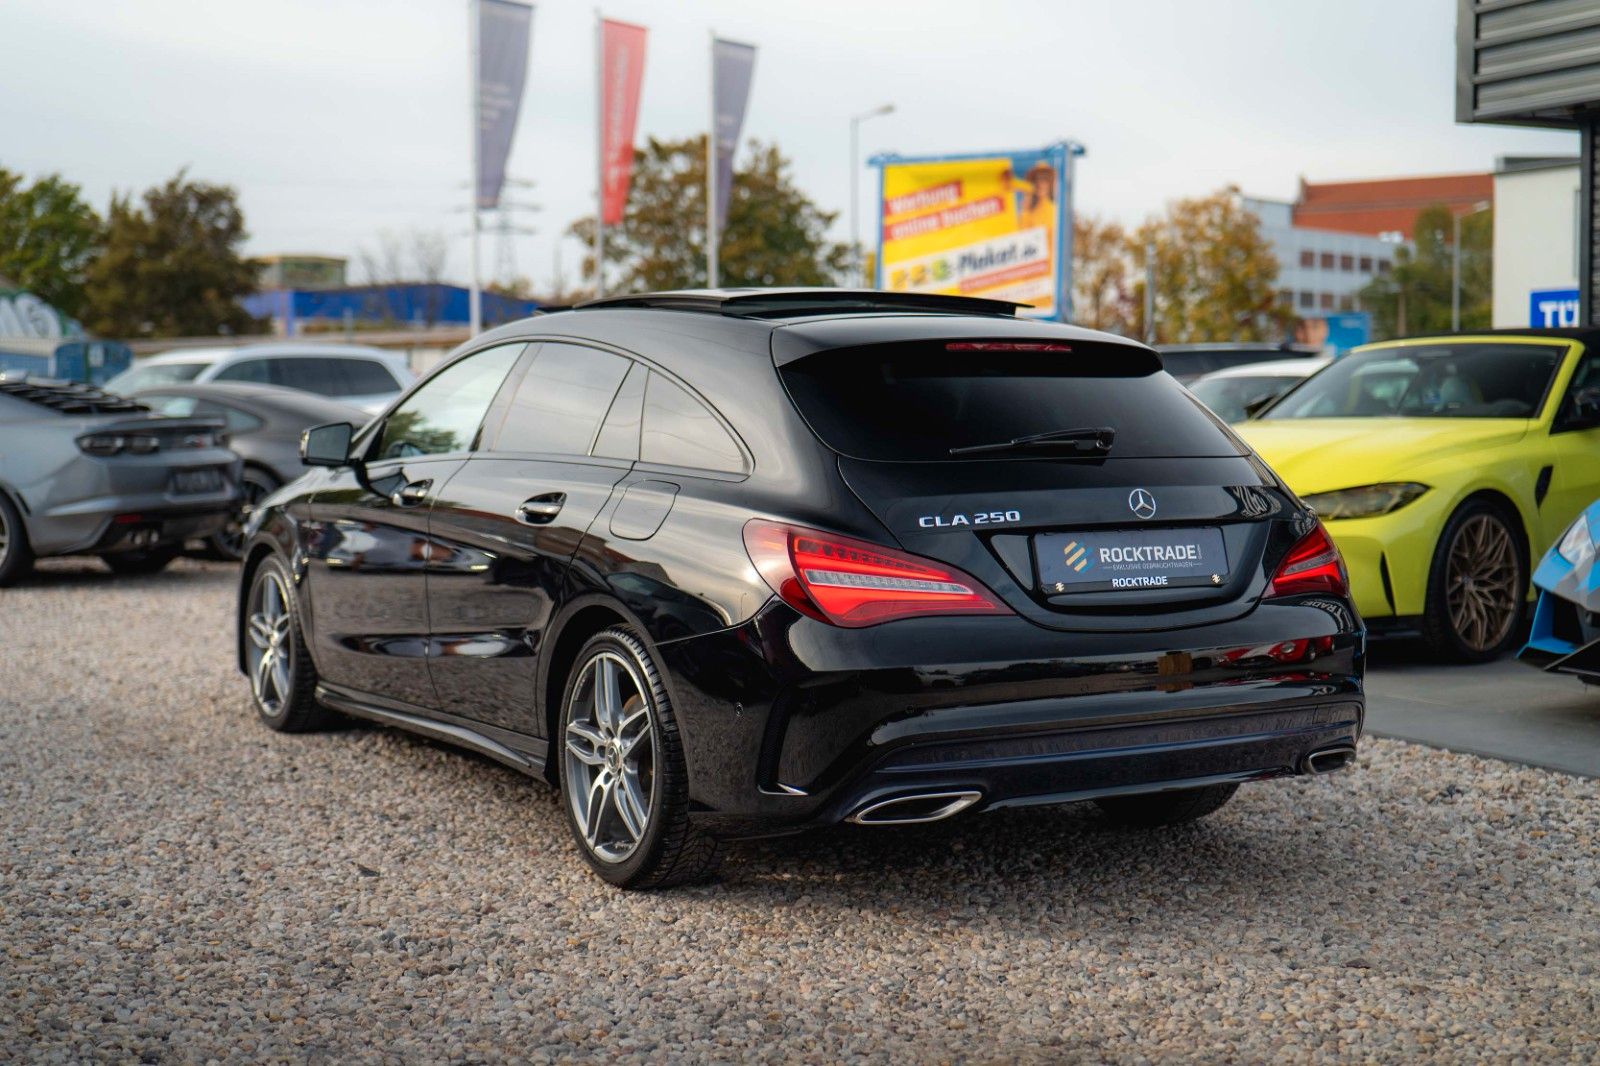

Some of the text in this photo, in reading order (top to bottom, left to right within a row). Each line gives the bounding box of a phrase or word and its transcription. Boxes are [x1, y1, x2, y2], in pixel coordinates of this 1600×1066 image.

[891, 215, 937, 240] online
[919, 510, 1020, 528] CLA 250
[1100, 545, 1197, 563] ROCKTRADE
[1112, 576, 1168, 588] ROCKTRADE
